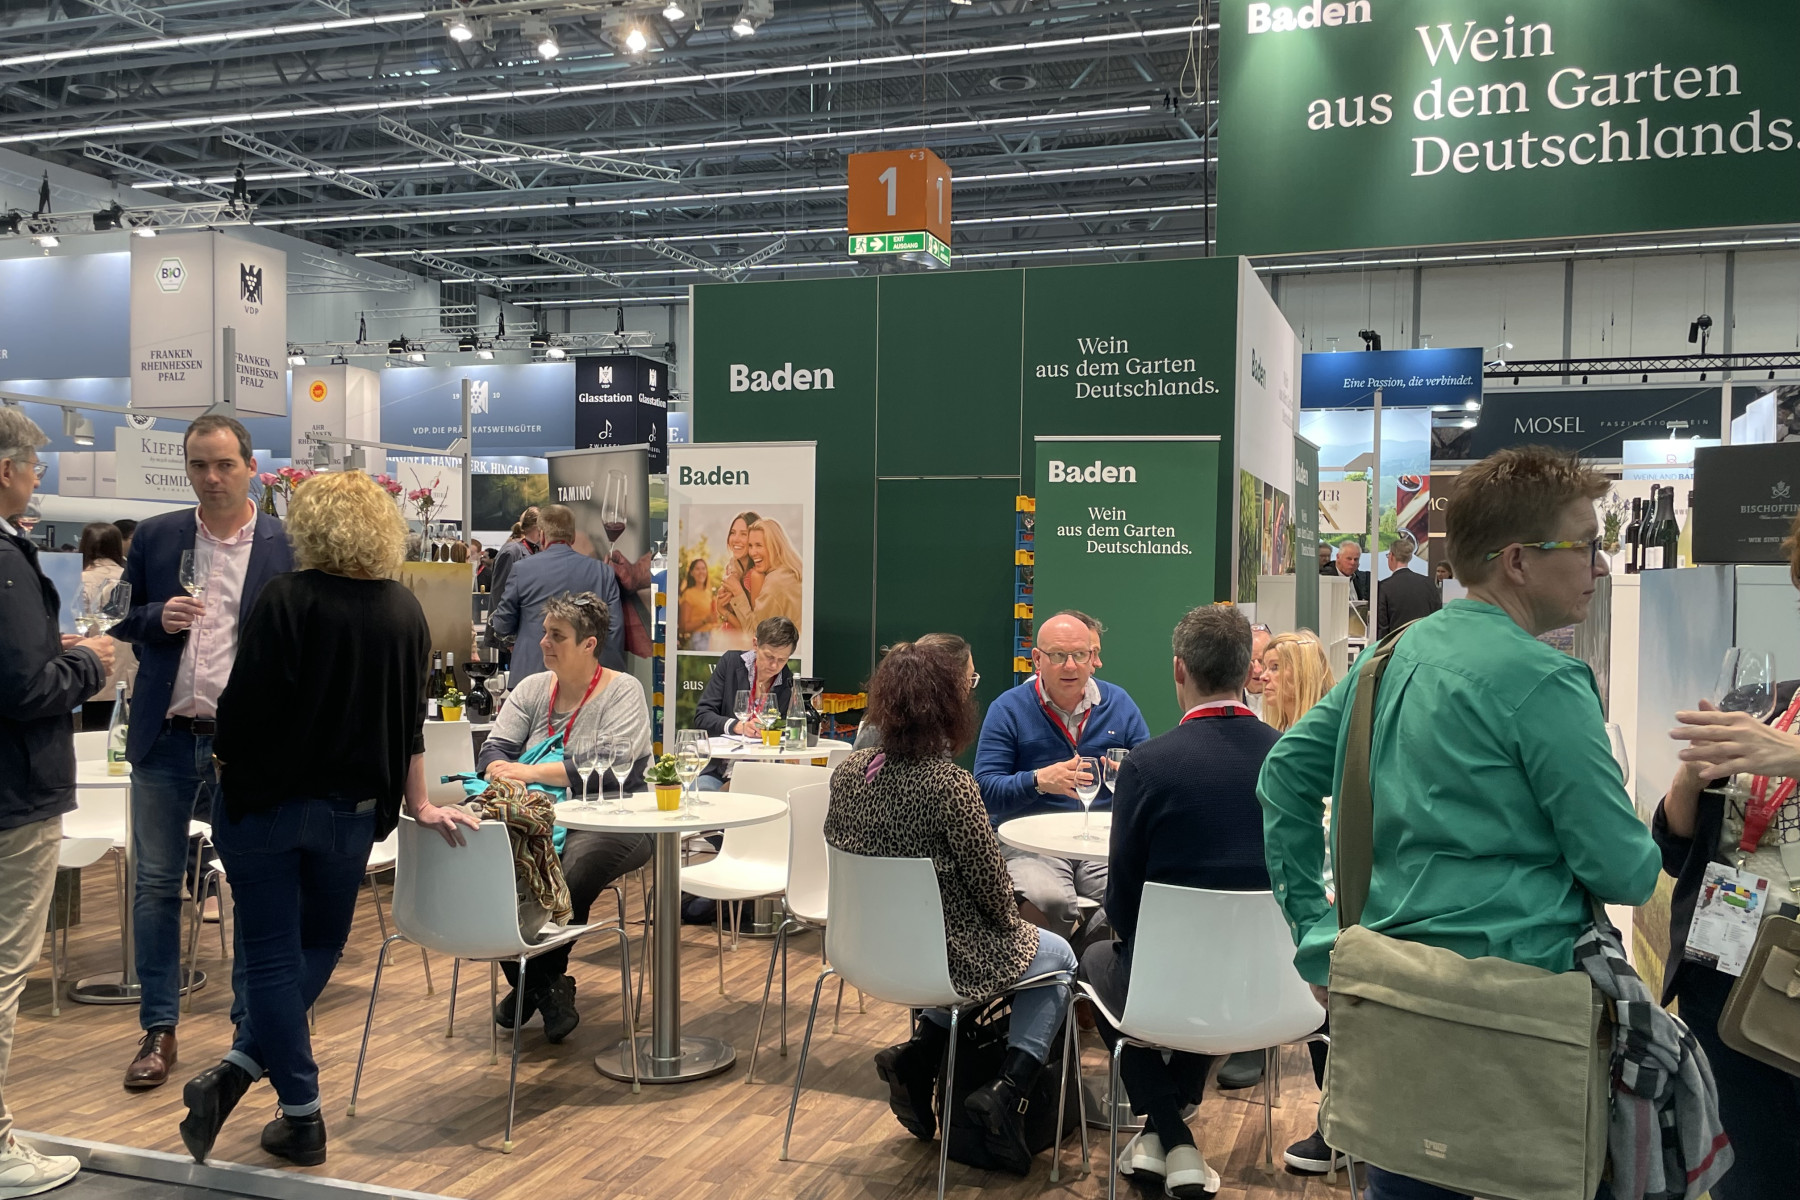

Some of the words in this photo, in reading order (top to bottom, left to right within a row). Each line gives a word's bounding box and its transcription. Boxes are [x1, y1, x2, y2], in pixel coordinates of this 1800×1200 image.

[1247, 0, 1373, 34] Baden
[1414, 14, 1555, 67] Wein
[1306, 91, 1394, 131] aus
[1412, 78, 1530, 121] dem
[1546, 62, 1741, 111] Garten
[918, 151, 925, 161] 3
[878, 166, 897, 217] 1
[936, 177, 944, 224] 1
[893, 235, 905, 243] EXIT
[893, 242, 919, 250] AUSGANG
[244, 305, 259, 315] VDP
[1077, 336, 1129, 355] Wein
[150, 349, 193, 360] FRANKEN
[141, 360, 203, 371] RHEINHESSEN
[236, 364, 279, 380] EINHESSEN
[1035, 363, 1069, 378] aus
[1075, 359, 1120, 377] dem
[1125, 357, 1196, 375] Garten
[1251, 347, 1267, 390] Baden
[158, 371, 186, 382] PFALZ
[240, 375, 264, 388] PFALZ
[729, 362, 836, 393] Baden
[1343, 378, 1366, 388] Eine
[1367, 377, 1406, 388] Passion,
[1408, 375, 1424, 386] die
[1425, 374, 1474, 386] verbindet.
[1075, 376, 1220, 399] Deutschlands.
[578, 392, 633, 403] Glasstation
[638, 392, 667, 409] Glasstation
[412, 426, 431, 434] VDP.
[432, 426, 445, 434] DIE
[447, 424, 542, 434] PRÄKATSWEINGÜTER
[1513, 416, 1586, 434] MOSEL
[141, 438, 184, 456] KIEFE
[679, 465, 750, 486] Baden
[1048, 460, 1138, 483] Baden
[1632, 473, 1678, 481] WEINLAND
[144, 473, 192, 487] SCHMID
[557, 485, 592, 502] TAMINO
[1087, 506, 1127, 521] Wein
[1056, 525, 1083, 537] aus
[1086, 523, 1120, 537] dem
[1123, 523, 1176, 538] Garten
[1086, 540, 1193, 555] Deutschlands.
[682, 680, 704, 691] aus
